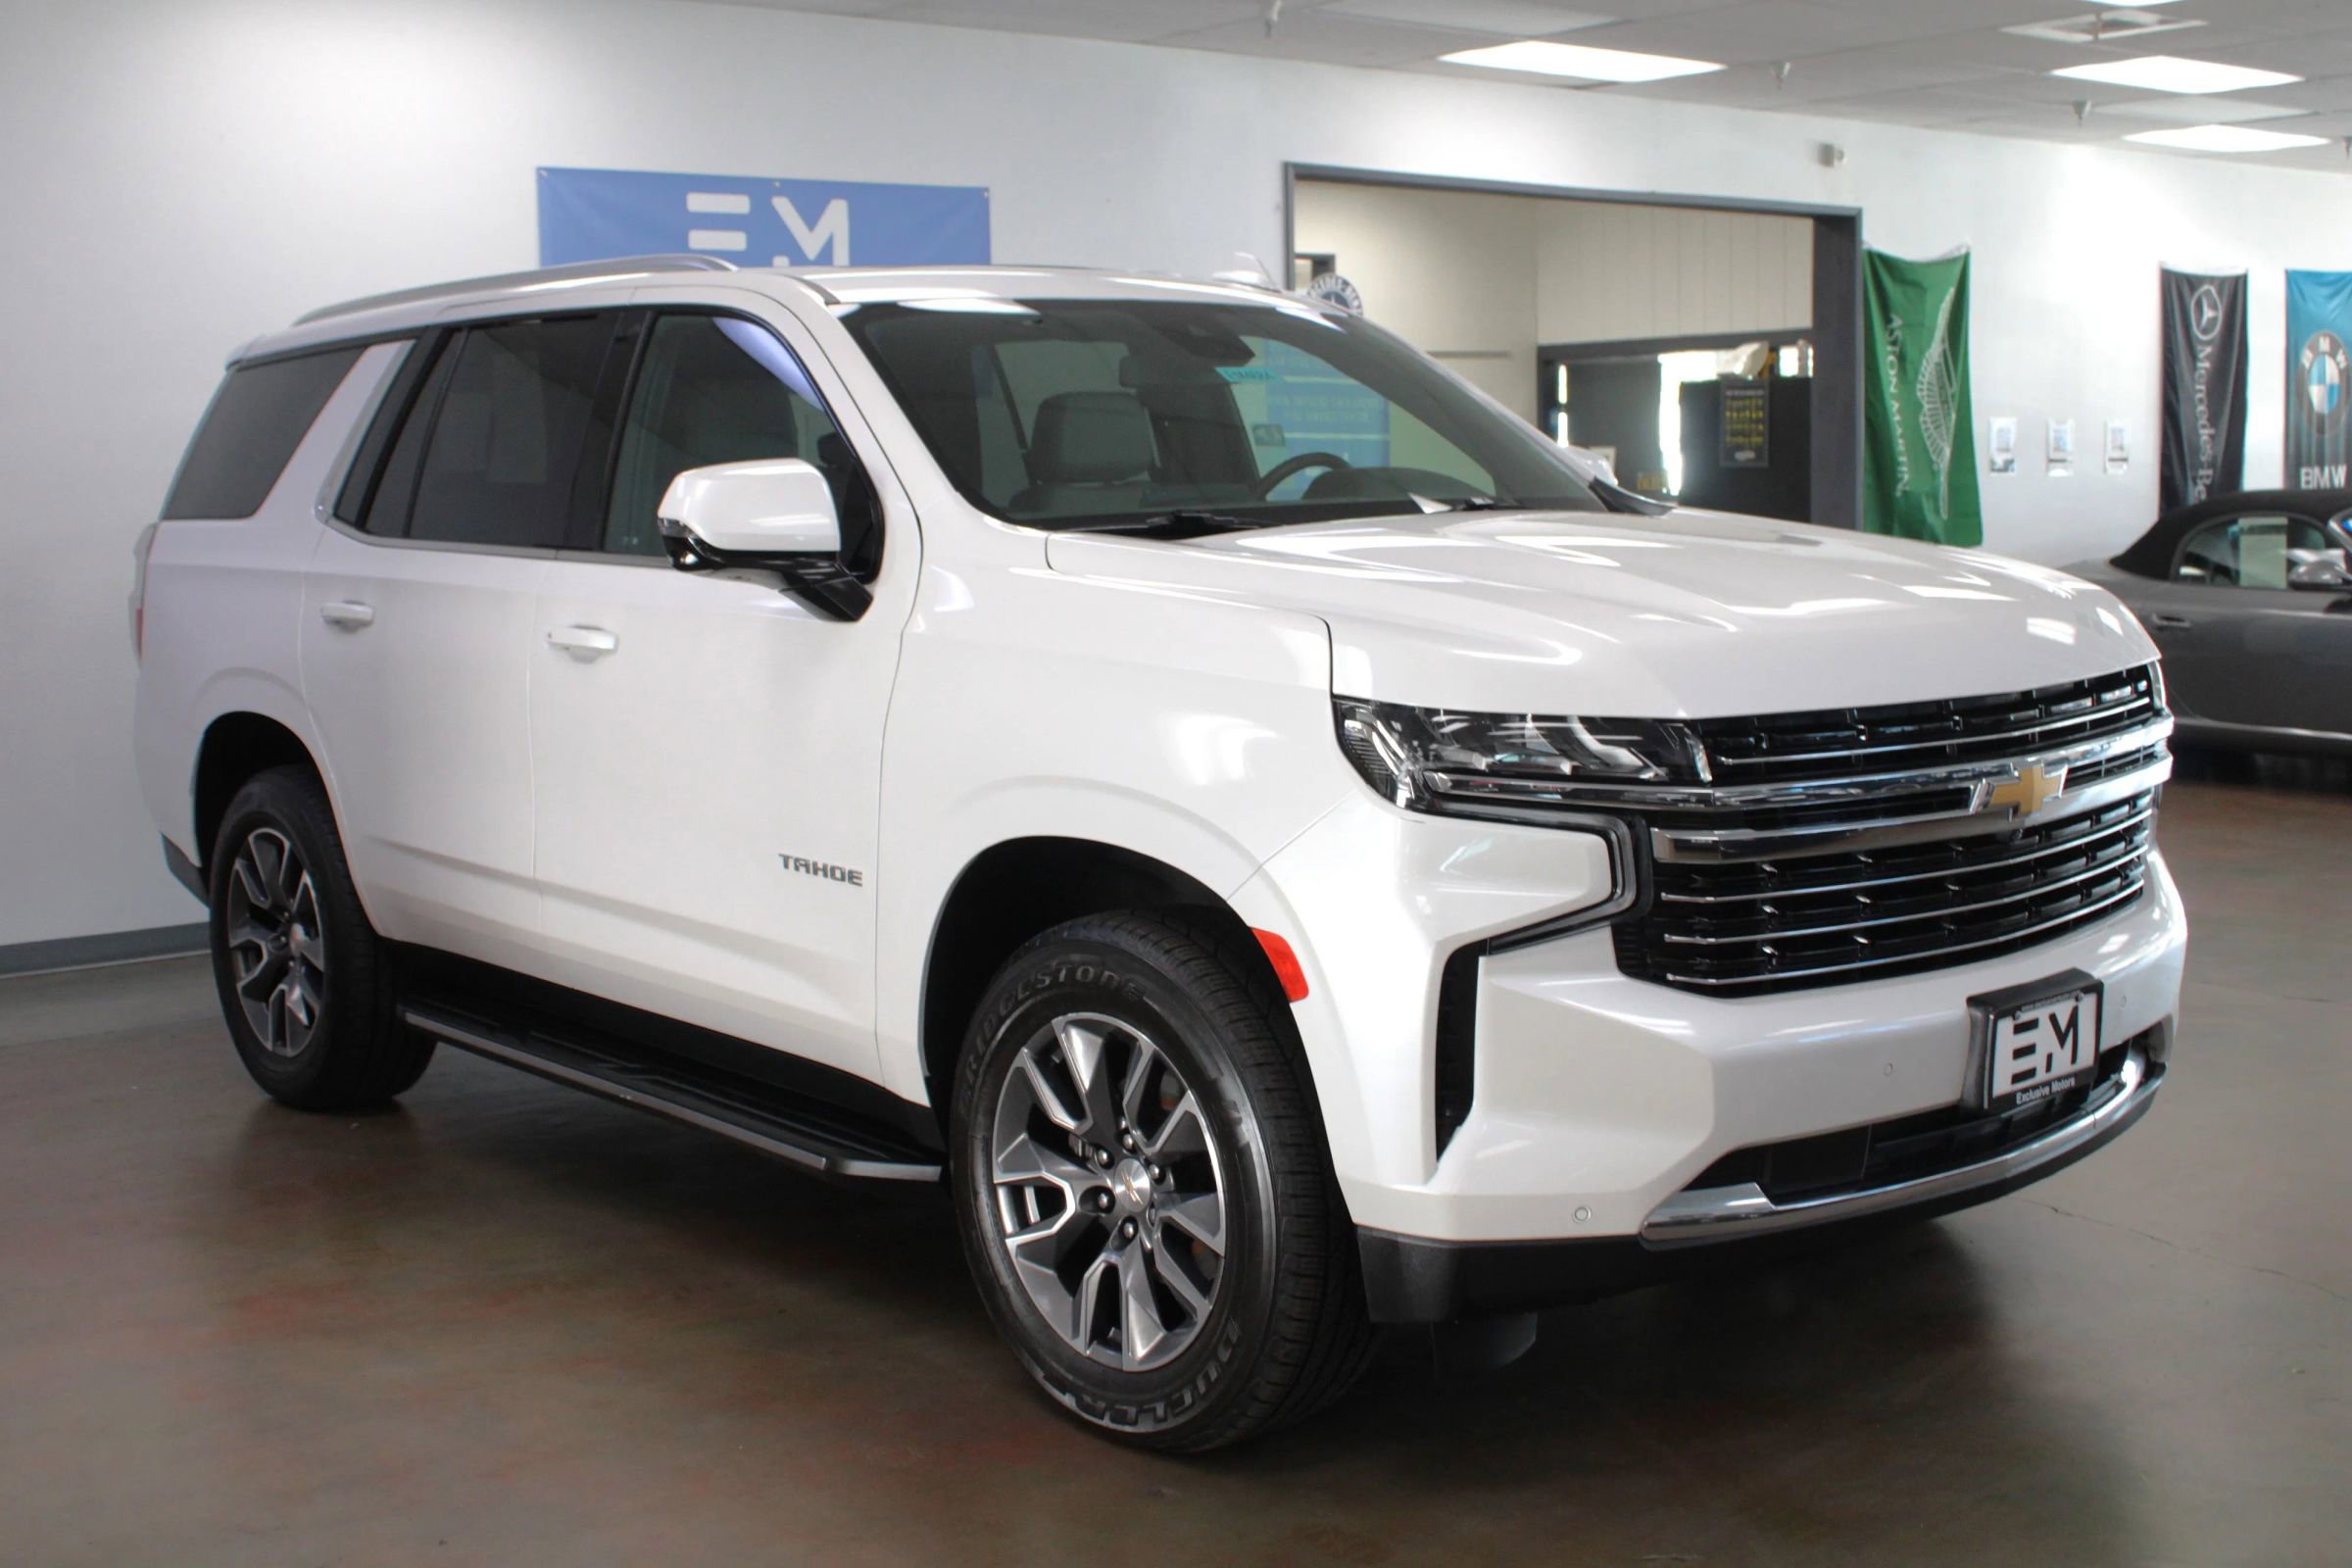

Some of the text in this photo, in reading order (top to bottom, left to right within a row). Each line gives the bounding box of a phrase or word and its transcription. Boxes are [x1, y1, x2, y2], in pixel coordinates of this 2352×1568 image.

[686, 192, 850, 267] EM
[1886, 313, 1903, 393] ASTON
[2194, 345, 2216, 504] Mercedes-Be
[2300, 465, 2347, 489] BMW
[777, 853, 862, 887] TAHOE
[2011, 1004, 2080, 1085] EM
[2015, 1076, 2076, 1105] Exclusive Motors
